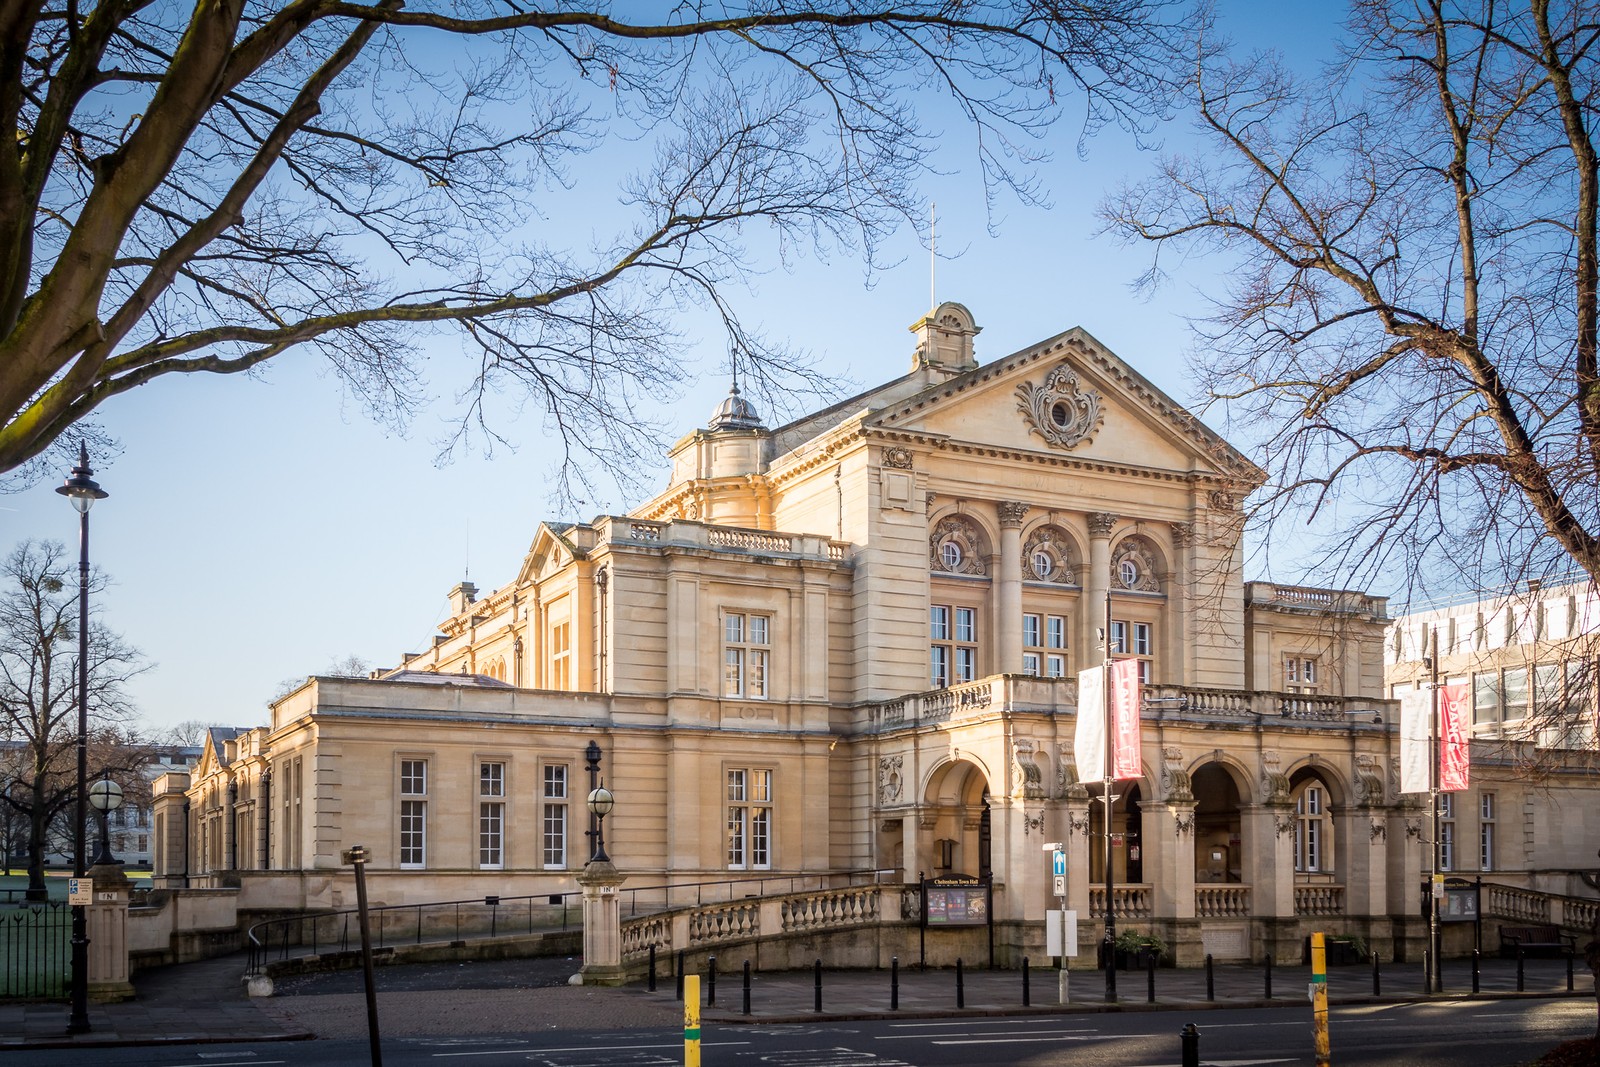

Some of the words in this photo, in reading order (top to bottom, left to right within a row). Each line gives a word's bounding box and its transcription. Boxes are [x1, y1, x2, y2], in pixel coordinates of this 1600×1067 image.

[1120, 678, 1130, 735] LAUGH
[1448, 702, 1459, 750] DANCE
[1057, 880, 1063, 891] R
